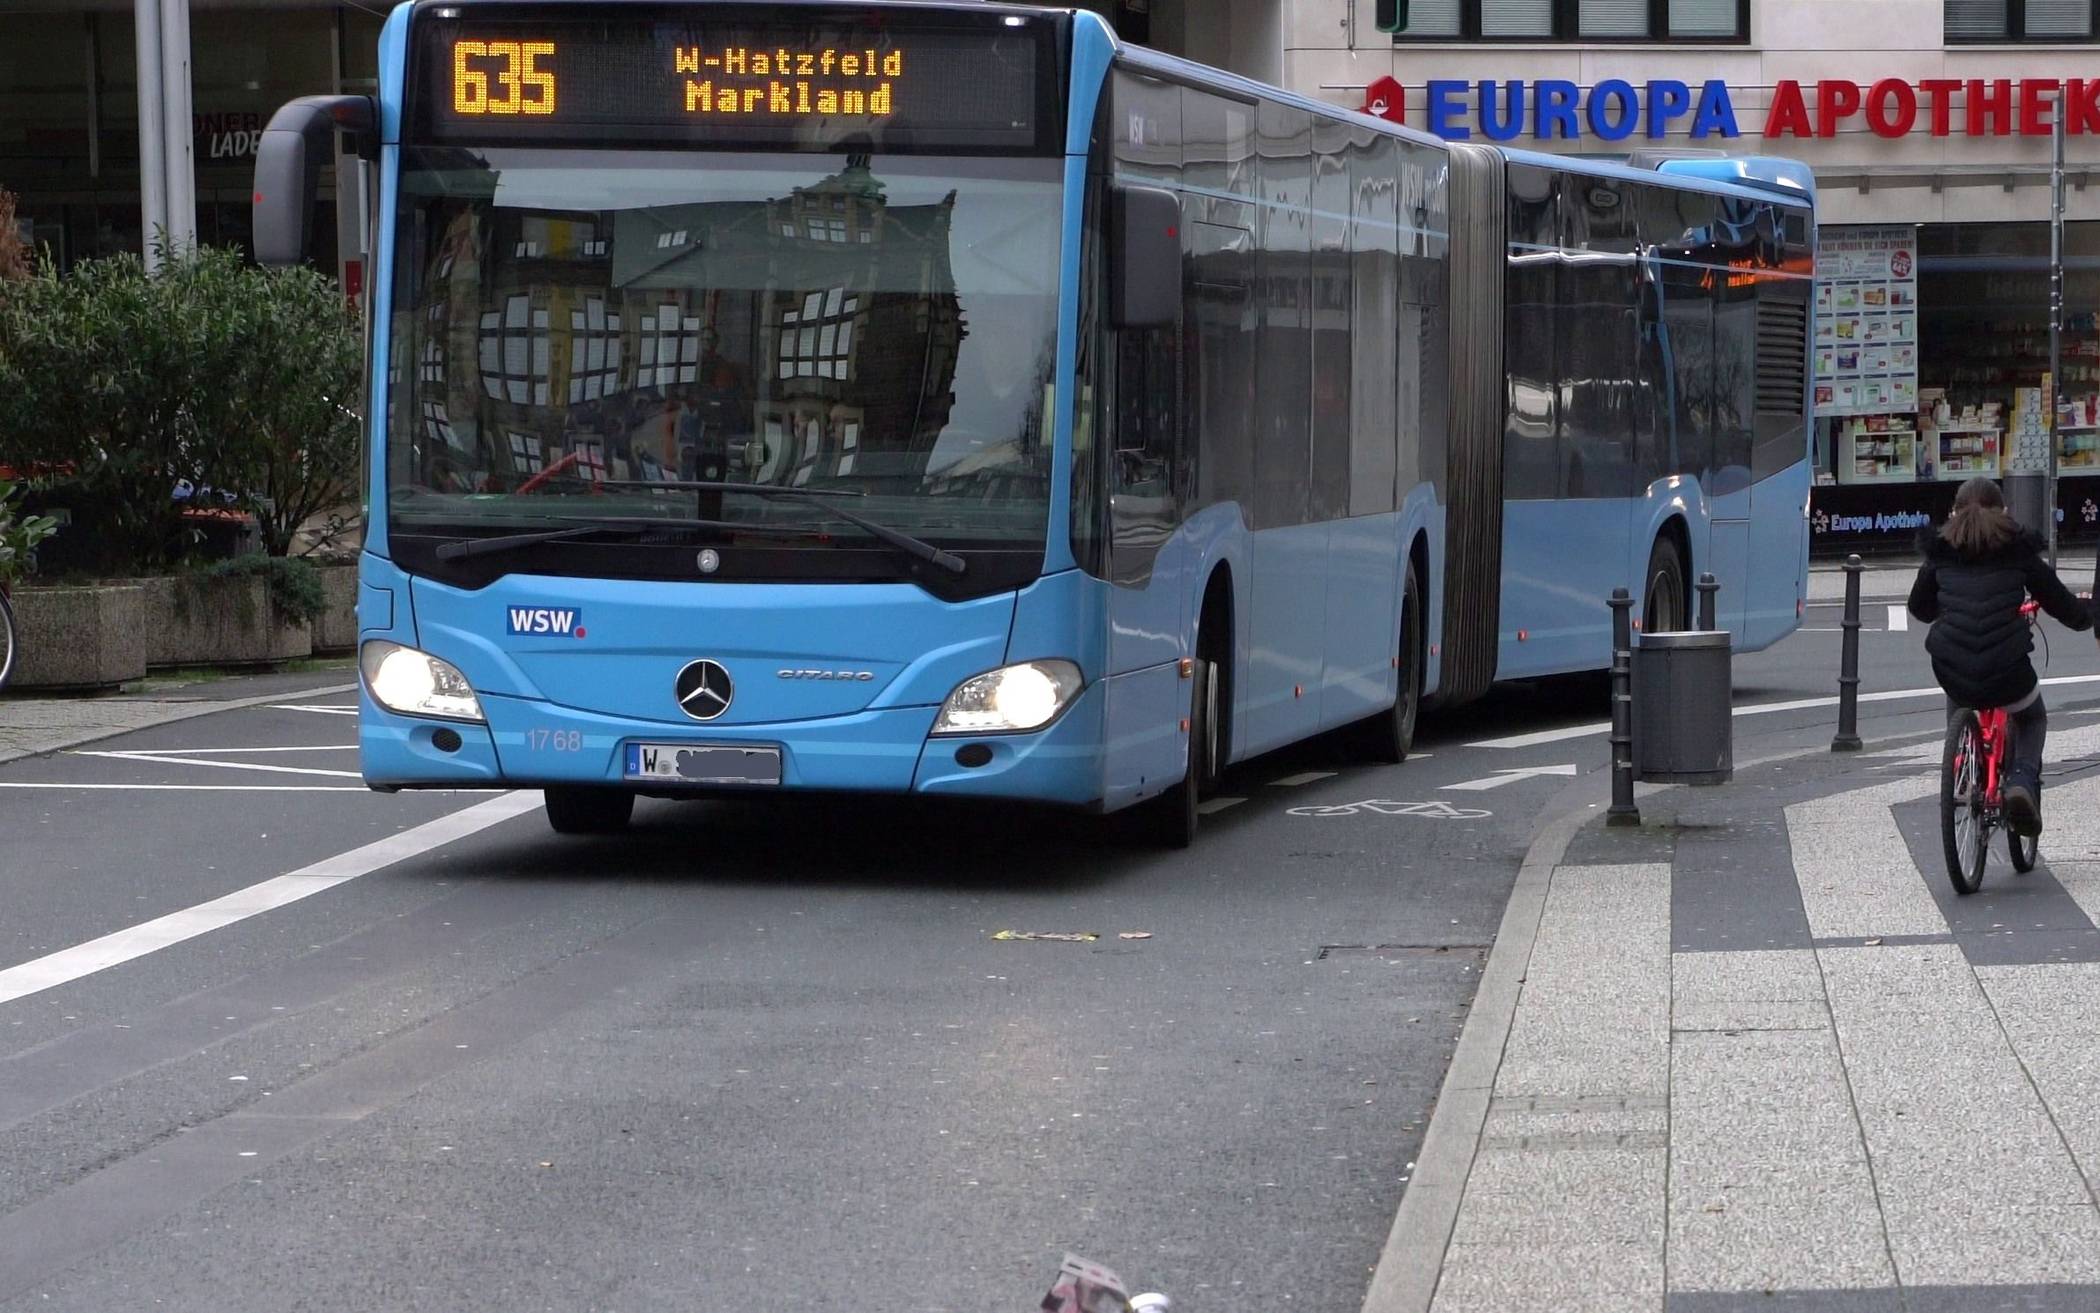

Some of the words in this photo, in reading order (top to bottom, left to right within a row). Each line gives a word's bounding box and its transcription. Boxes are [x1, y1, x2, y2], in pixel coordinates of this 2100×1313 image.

[675, 48, 901, 76] W-Hatzfeld
[454, 41, 554, 114] 635
[686, 80, 891, 114] Markland
[1427, 79, 1739, 140] EUROPA
[1831, 514, 1872, 532] Europa
[1874, 510, 1930, 532] Apotheke
[510, 608, 574, 633] WSW
[776, 668, 874, 681] CITARO
[526, 728, 581, 752] 1768
[643, 748, 657, 772] W
